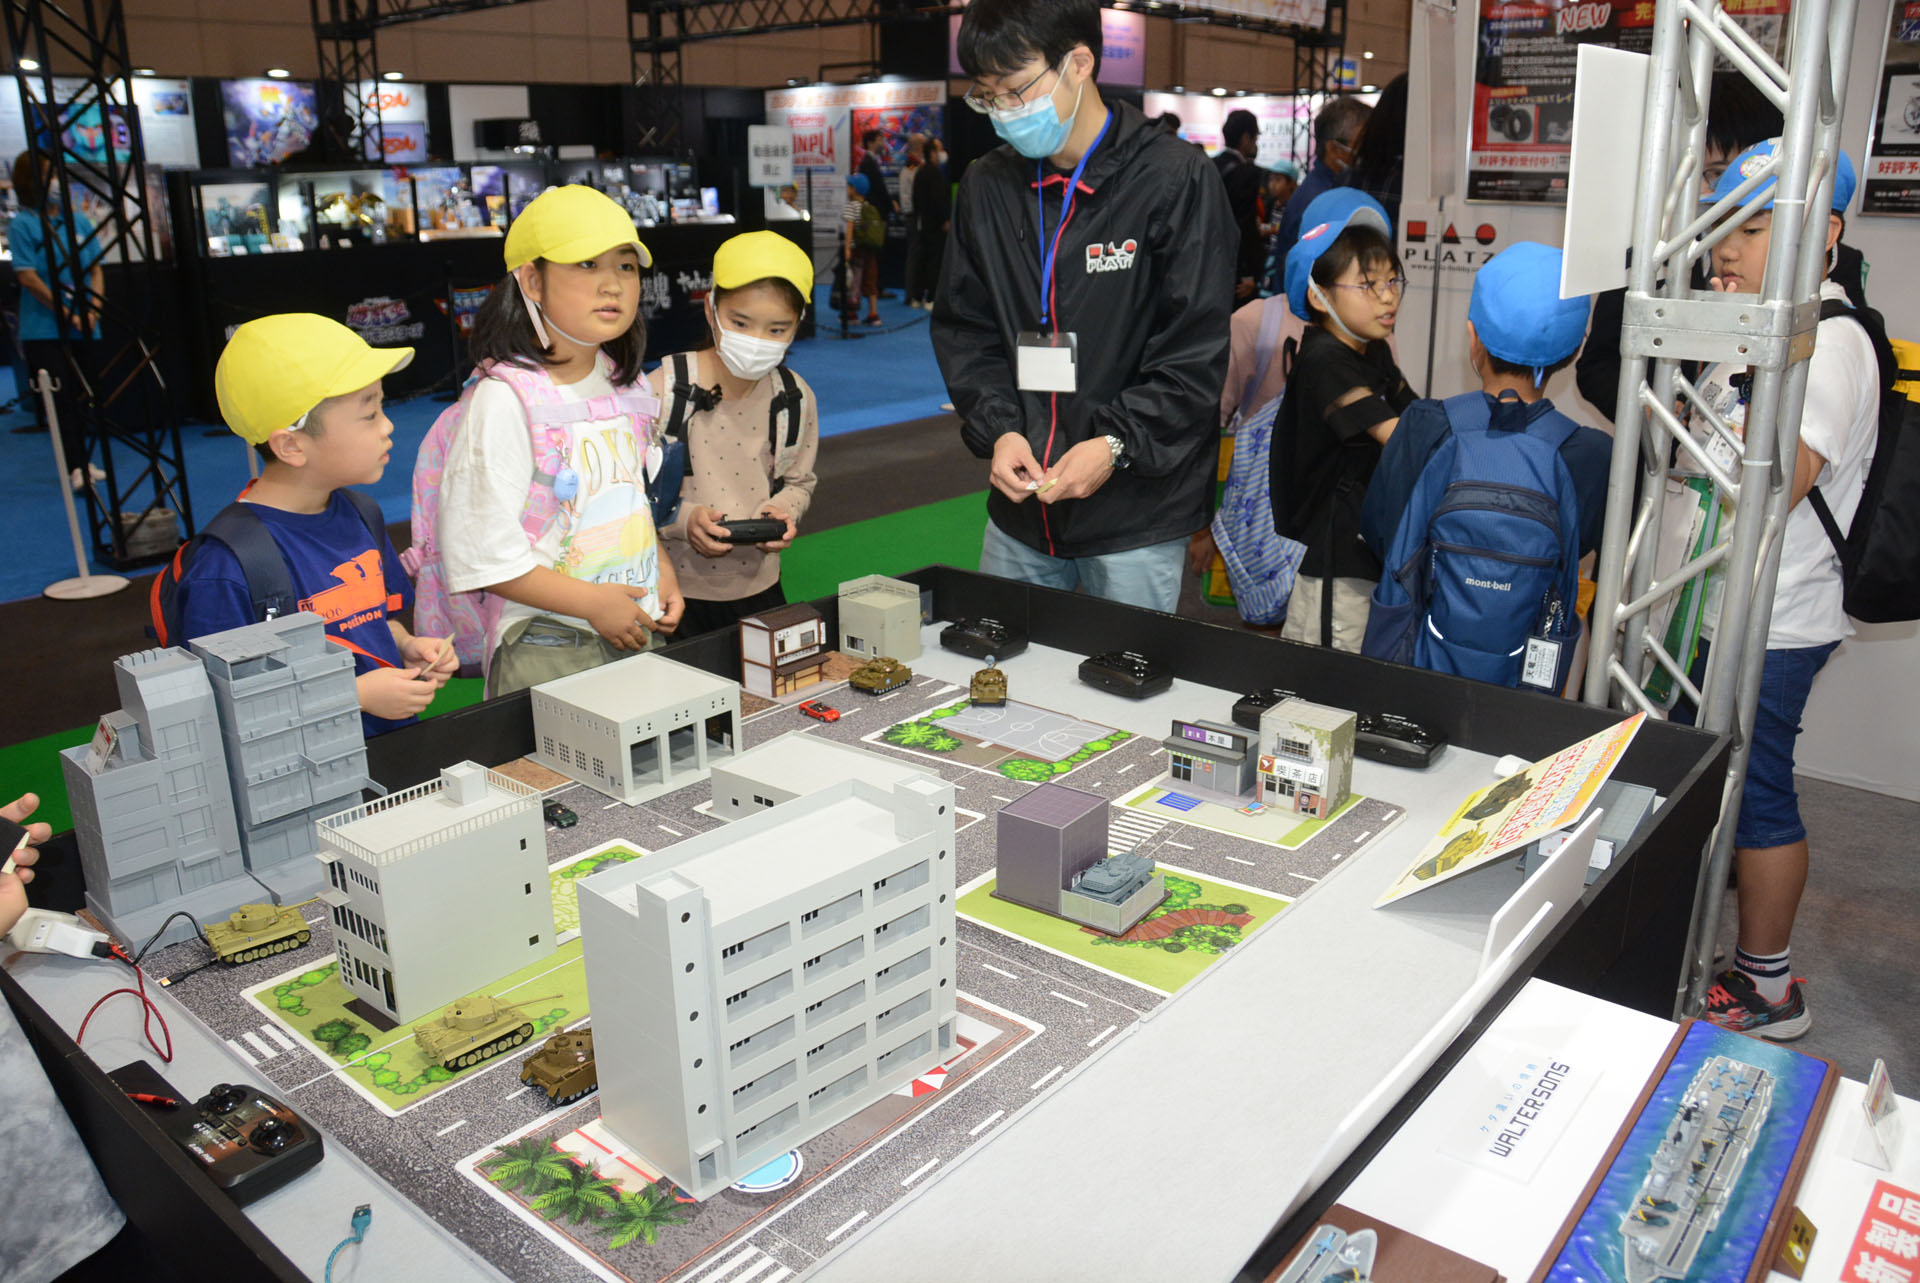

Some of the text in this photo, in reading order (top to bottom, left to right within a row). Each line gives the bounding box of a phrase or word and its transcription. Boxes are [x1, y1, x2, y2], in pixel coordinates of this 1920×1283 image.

[1556, 3, 1611, 34] NEW
[1879, 161, 1920, 175] 好評予
[1405, 247, 1494, 265] PLATZ
[1276, 763, 1319, 784] 喫茶店
[1488, 1061, 1570, 1158] WALTERSONS
